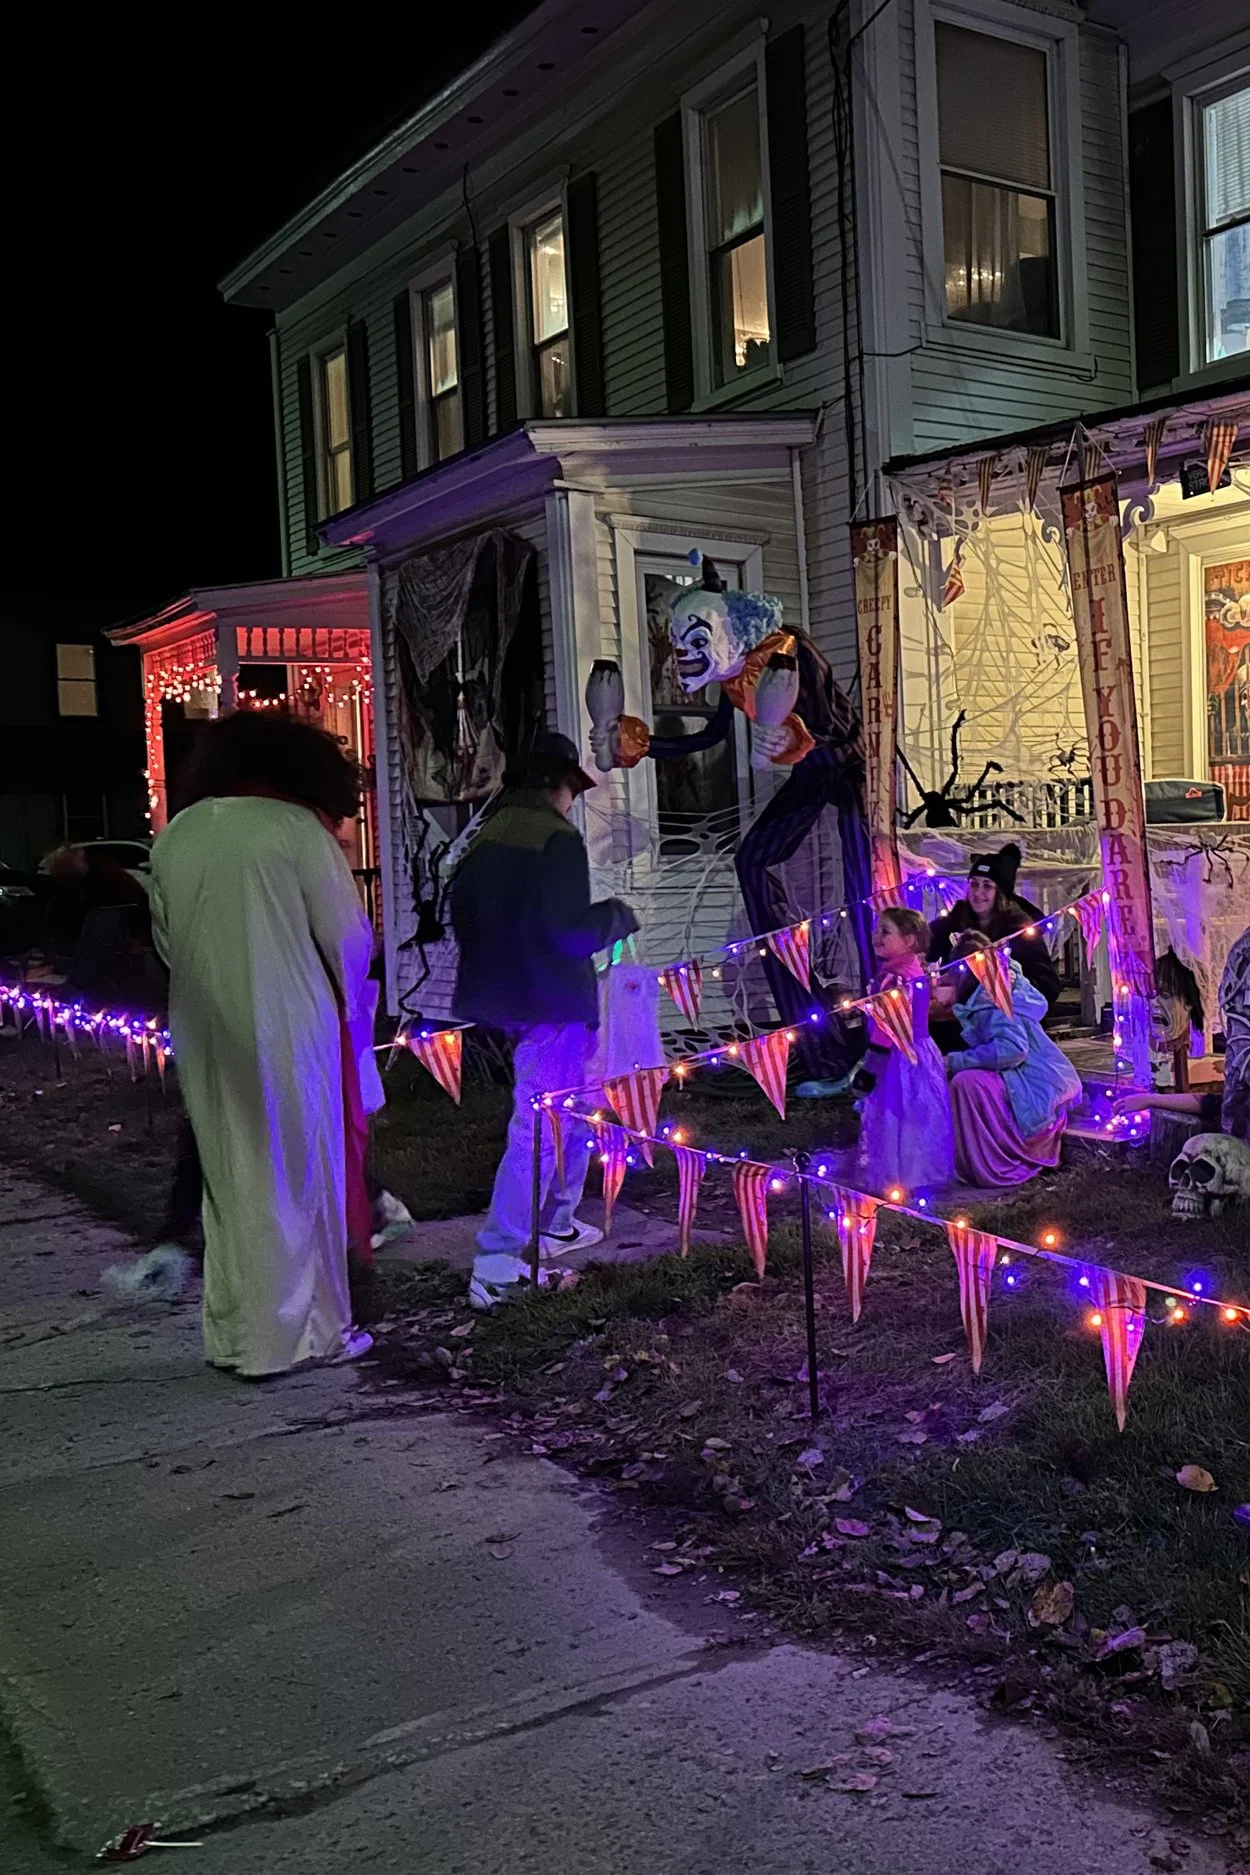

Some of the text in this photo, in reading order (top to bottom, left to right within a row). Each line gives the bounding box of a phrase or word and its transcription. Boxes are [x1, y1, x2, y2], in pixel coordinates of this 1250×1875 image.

[1072, 563, 1116, 592] ENTER
[857, 594, 892, 615] CREEPY
[1088, 597, 1135, 936] IF YOU DARE
